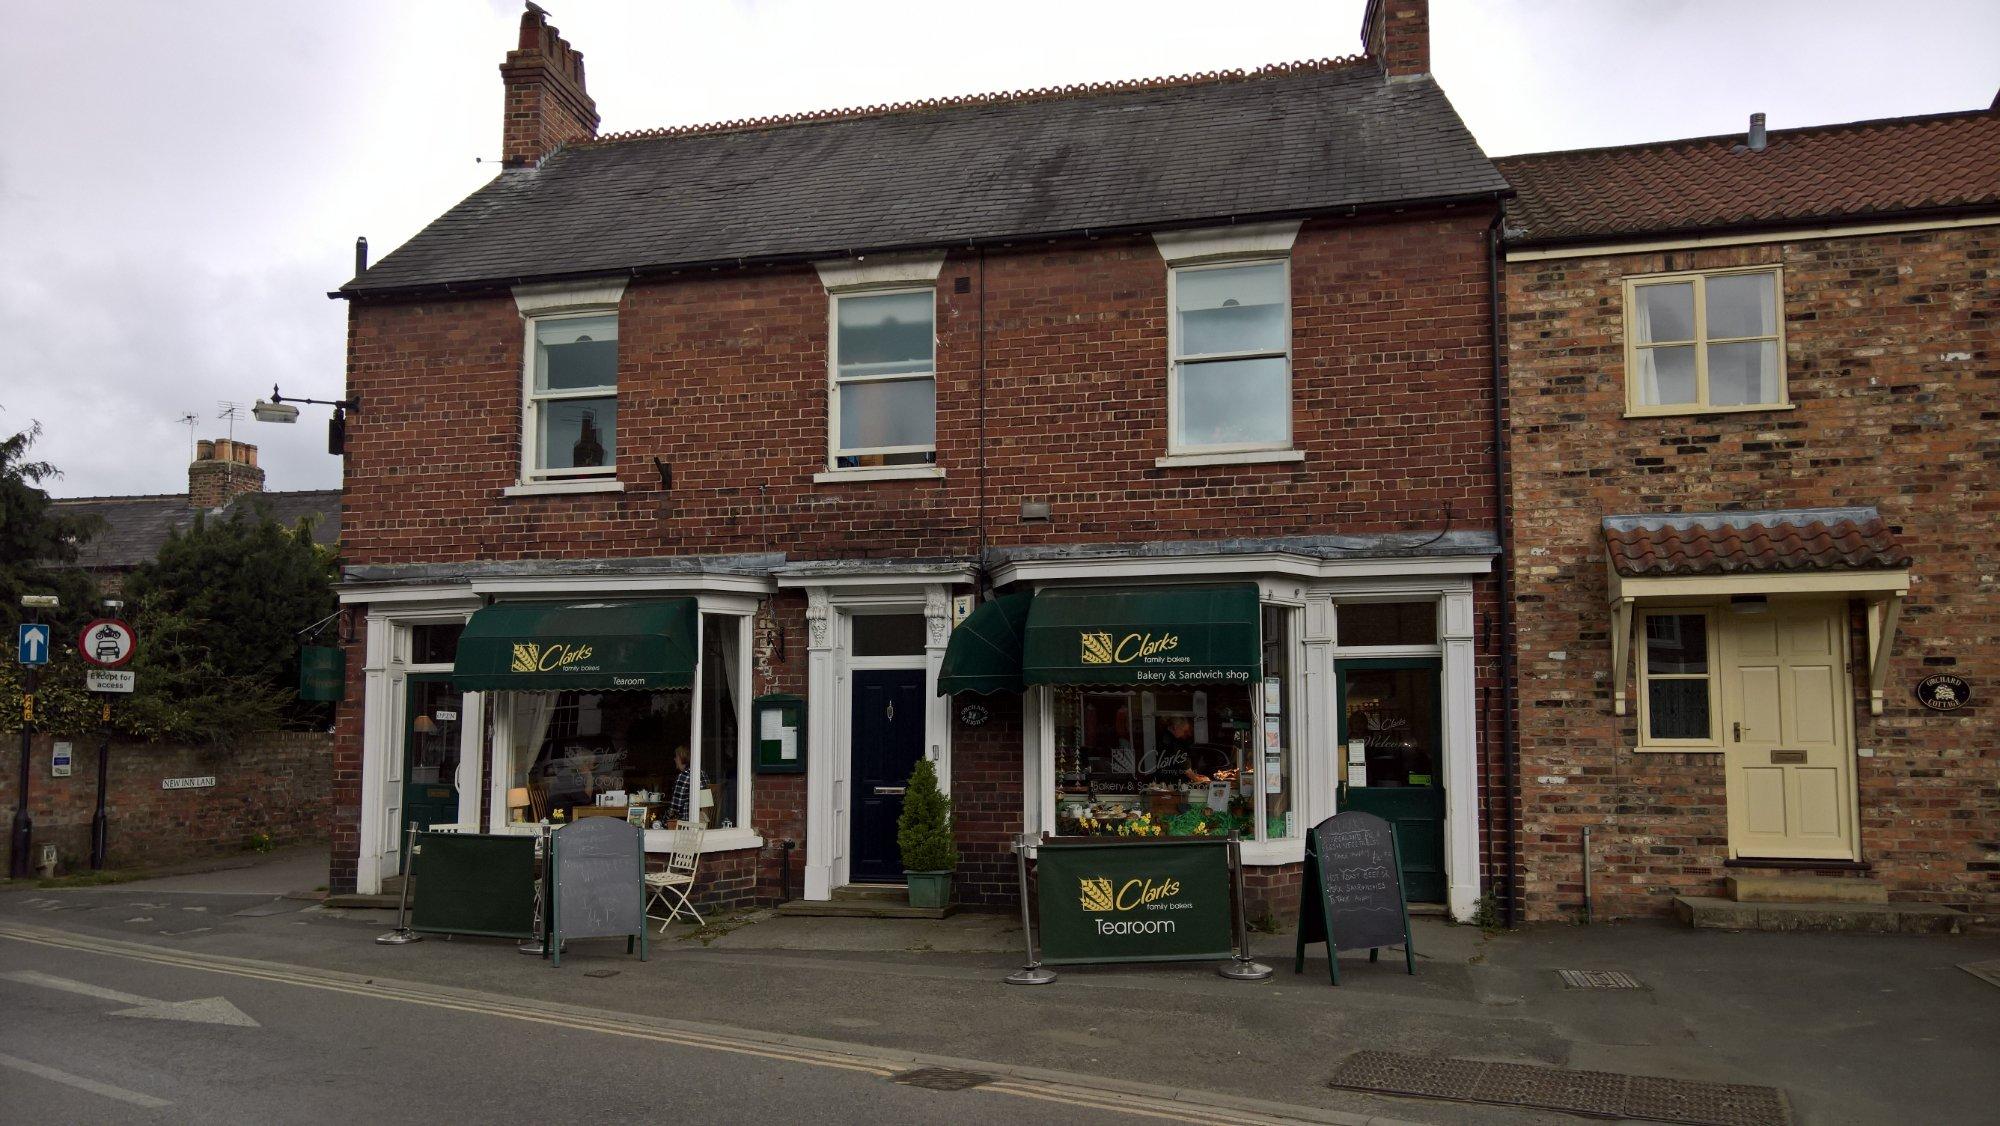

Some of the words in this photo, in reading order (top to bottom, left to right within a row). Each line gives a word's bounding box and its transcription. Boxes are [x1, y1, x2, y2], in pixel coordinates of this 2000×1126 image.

[1114, 633, 1179, 663] Clarks
[538, 643, 593, 671] Clarks
[1145, 656, 1165, 664] family
[1167, 655, 1191, 663] bakers
[90, 671, 118, 681] Except
[1137, 671, 1167, 682] Bakery
[1169, 671, 1177, 680] &
[1179, 669, 1223, 680] Sandwich
[1226, 669, 1250, 682] shop
[612, 676, 646, 686] Tearoom
[1925, 676, 1962, 687] ORCHARD
[1927, 698, 1961, 708] COTTAGE
[1138, 749, 1188, 774] Clarks
[164, 780, 180, 788] NEW
[182, 779, 194, 787] INN
[197, 778, 214, 786] LANE
[1127, 781, 1135, 790] &
[1115, 877, 1180, 911] Clarks
[1147, 903, 1168, 911] family
[1169, 902, 1193, 910] bakers
[1094, 918, 1176, 935] Tearoom
